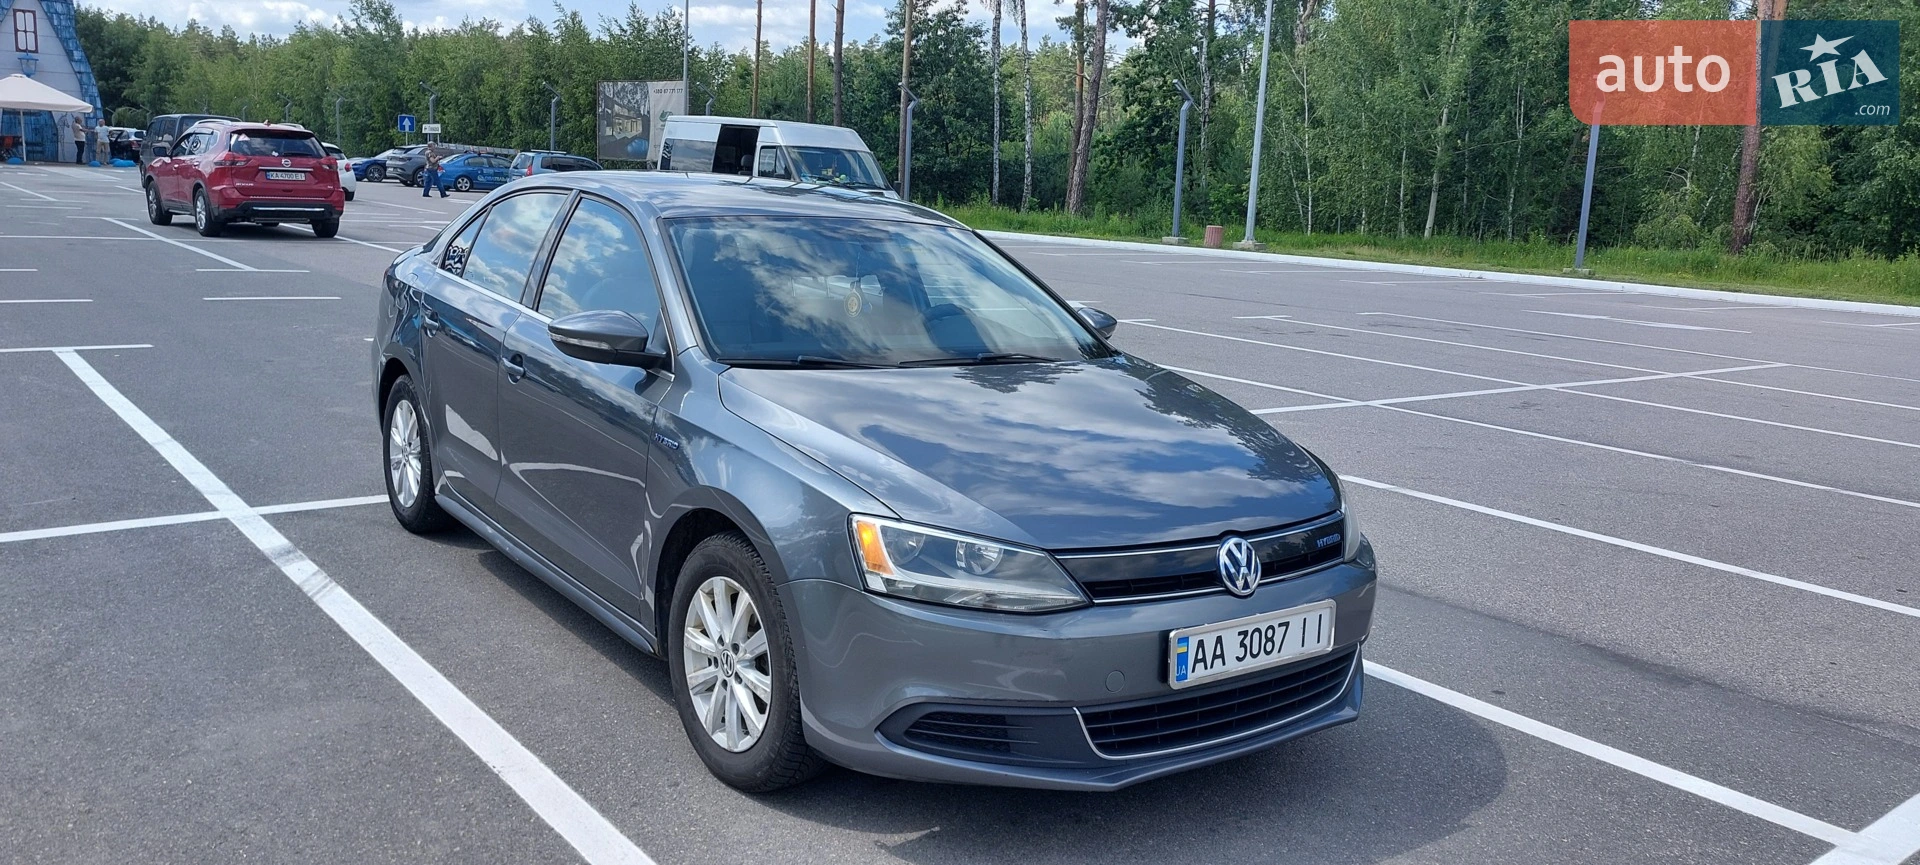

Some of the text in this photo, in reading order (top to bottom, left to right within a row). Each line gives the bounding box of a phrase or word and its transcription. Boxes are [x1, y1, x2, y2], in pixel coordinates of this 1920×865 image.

[1316, 533, 1341, 548] HYBRID
[1191, 635, 1226, 674] AA
[1235, 621, 1290, 663] 3087
